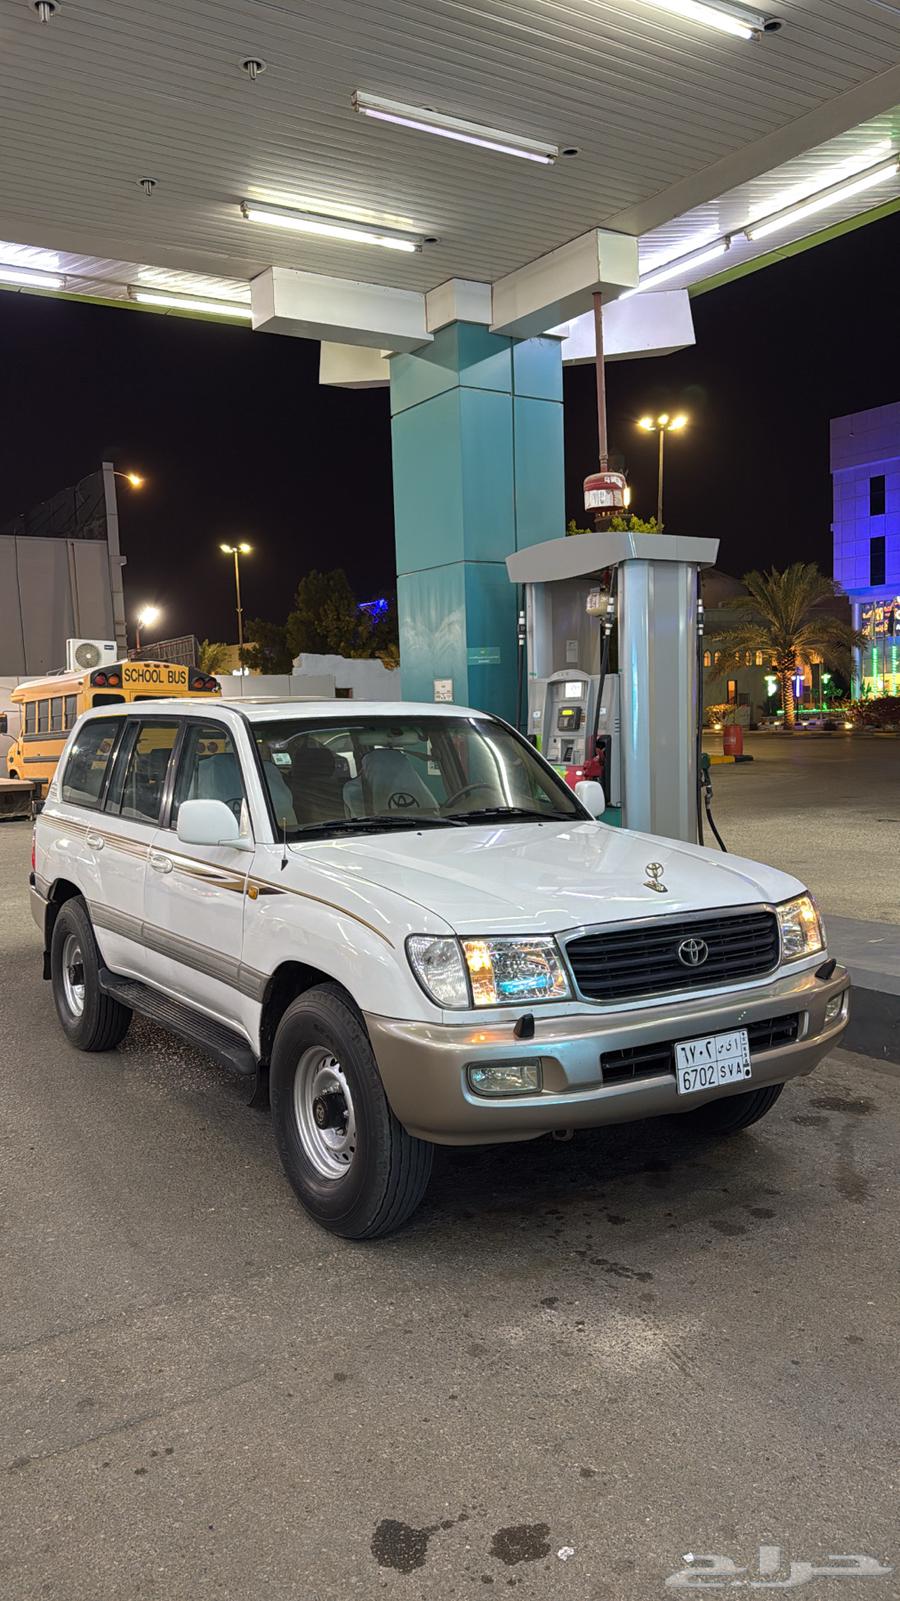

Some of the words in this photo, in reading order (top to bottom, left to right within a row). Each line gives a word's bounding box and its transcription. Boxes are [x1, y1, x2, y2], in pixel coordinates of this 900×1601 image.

[124, 668, 164, 683] SCHOOL
[167, 670, 186, 684] BUS
[681, 1041, 711, 1064] ٦٧٠٢
[683, 1066, 715, 1090] 6702
